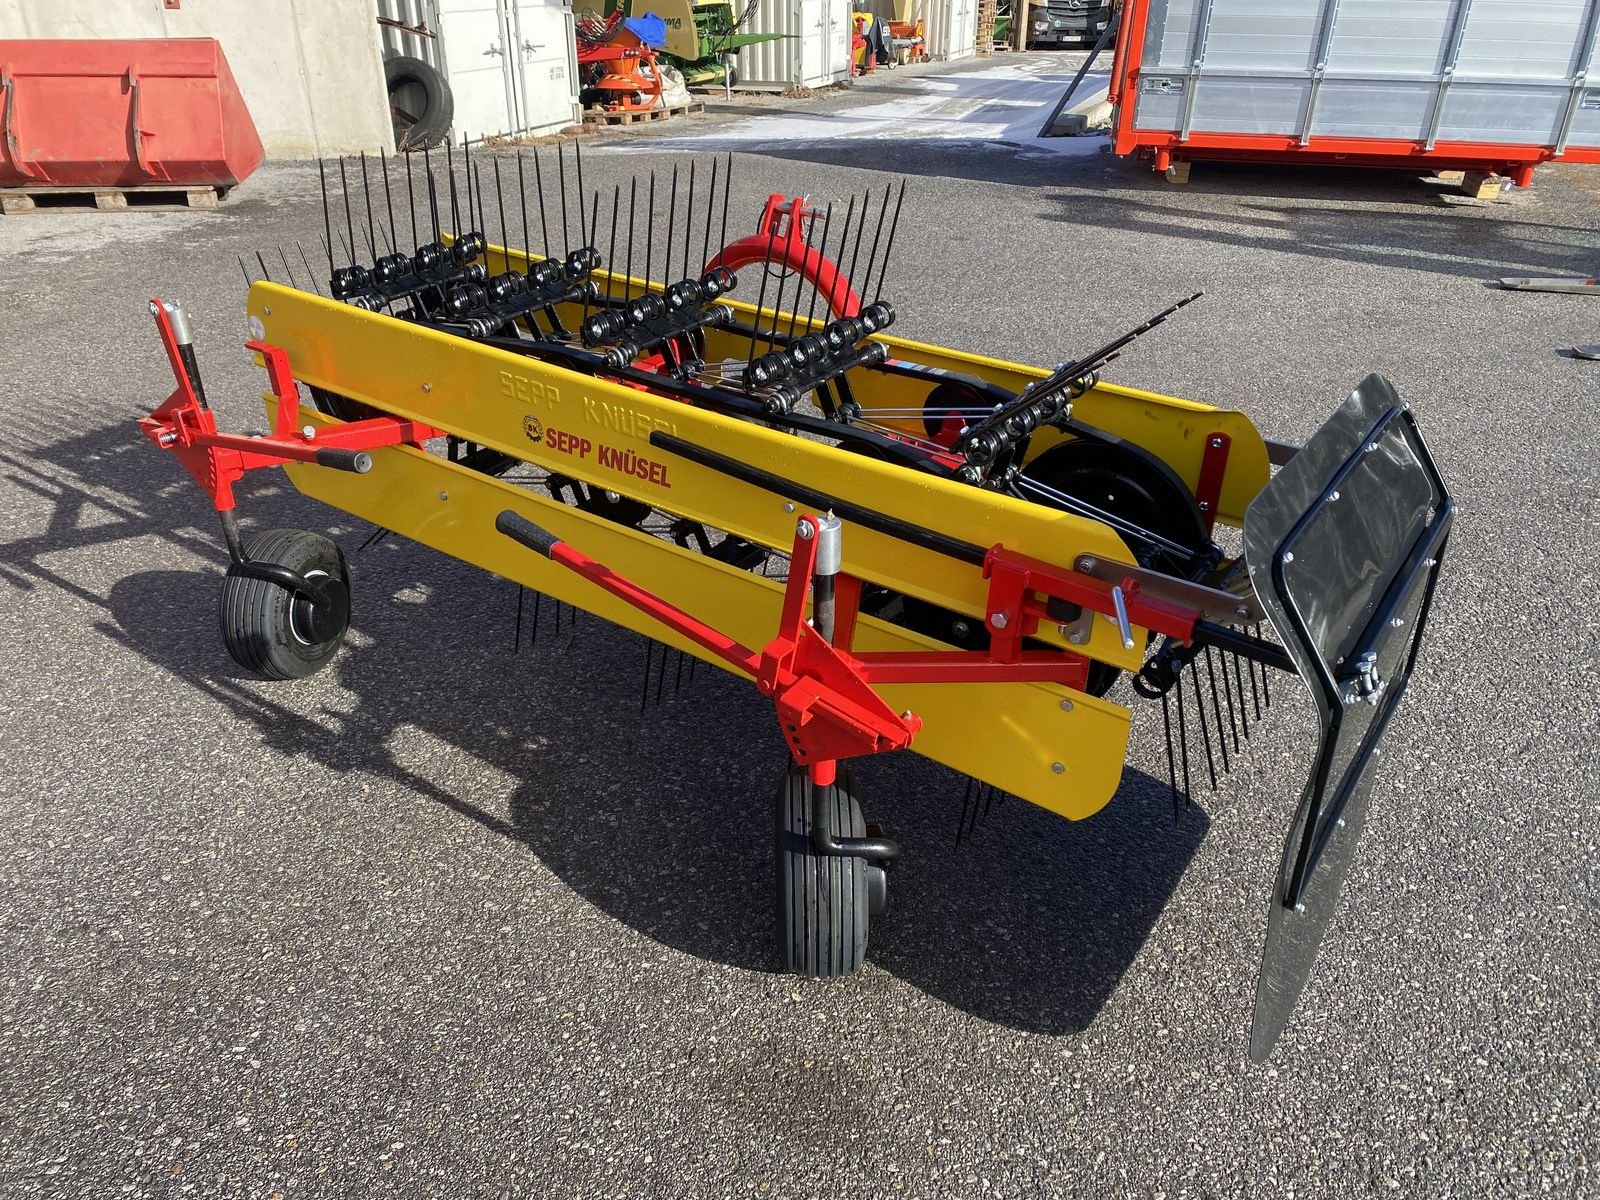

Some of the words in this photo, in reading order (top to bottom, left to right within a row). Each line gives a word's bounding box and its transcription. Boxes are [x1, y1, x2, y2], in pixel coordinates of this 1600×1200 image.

[500, 371, 560, 410] SEPP
[545, 427, 592, 459] SEPP
[597, 444, 672, 489] KNÜSEL
